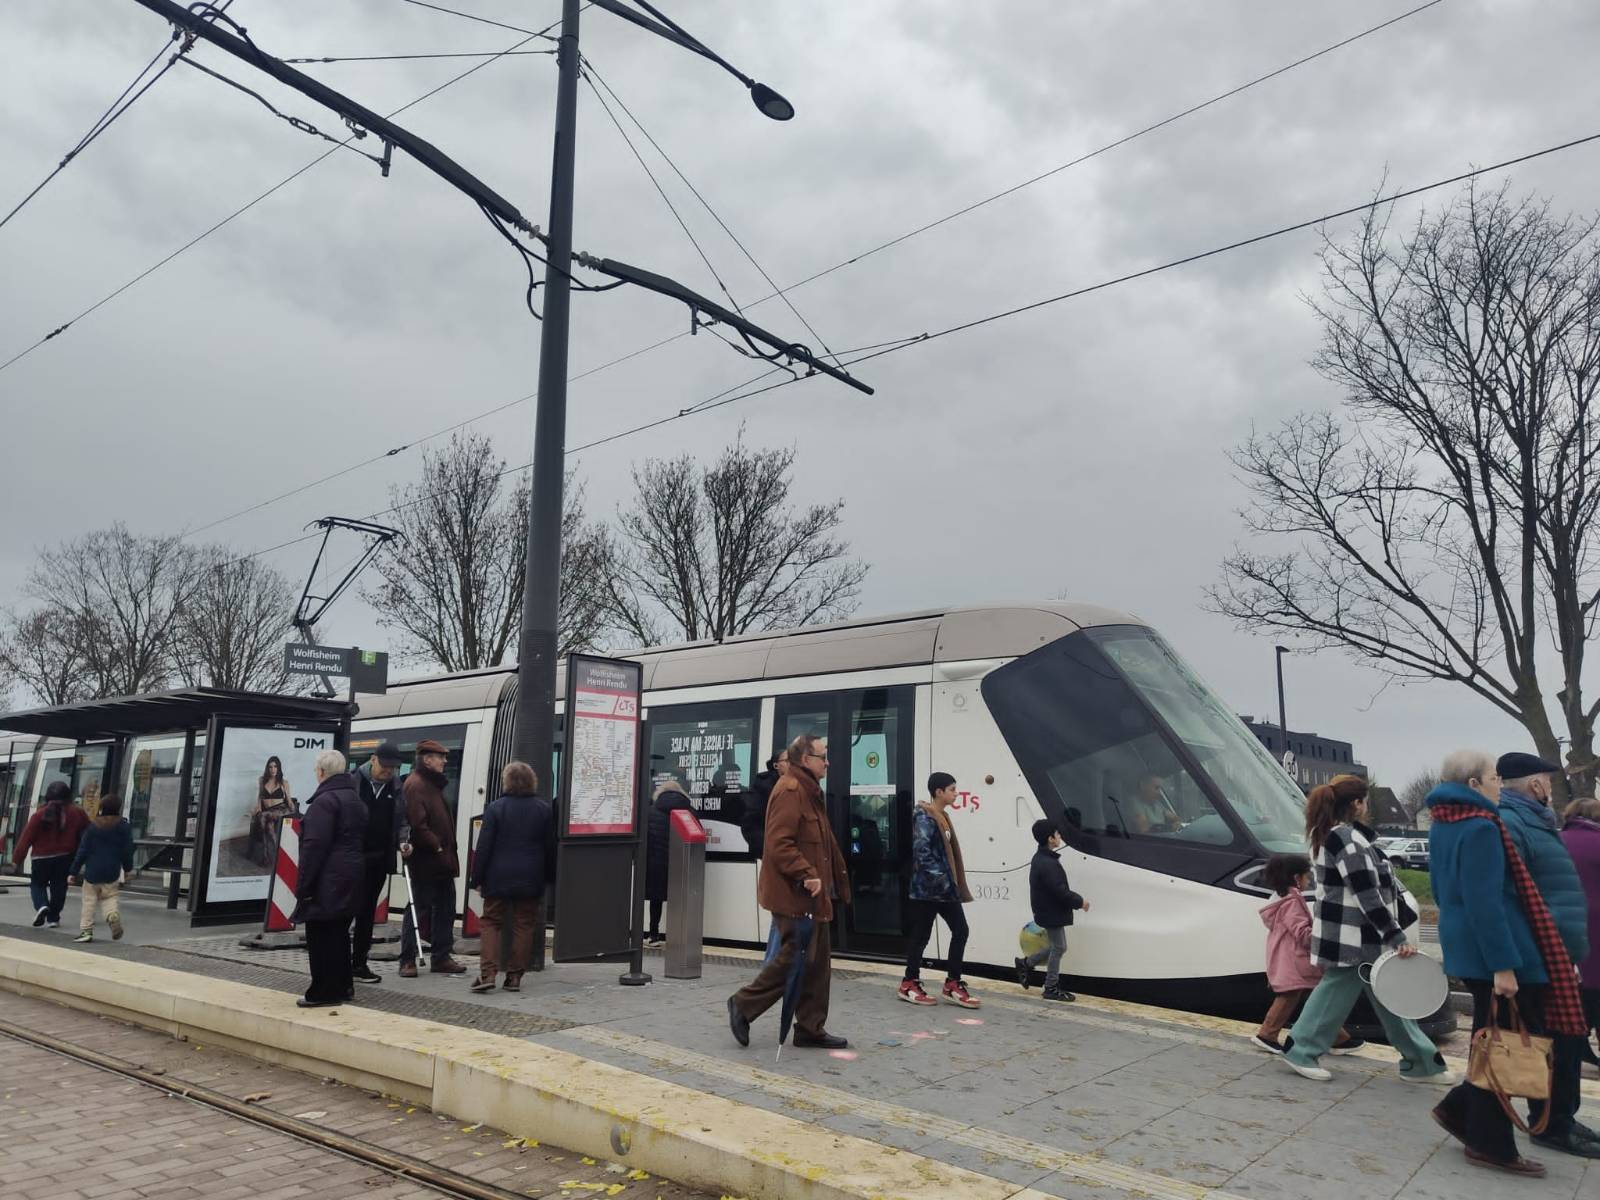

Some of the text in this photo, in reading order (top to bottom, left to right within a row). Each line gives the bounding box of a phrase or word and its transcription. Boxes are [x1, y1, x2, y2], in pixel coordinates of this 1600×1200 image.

[293, 648, 340, 661] Wolfisheim
[289, 660, 342, 673] Henri Rendu
[587, 677, 606, 687] Henri
[294, 738, 325, 749] DIM
[1288, 761, 1296, 776] 30
[975, 885, 1009, 900] 3032
